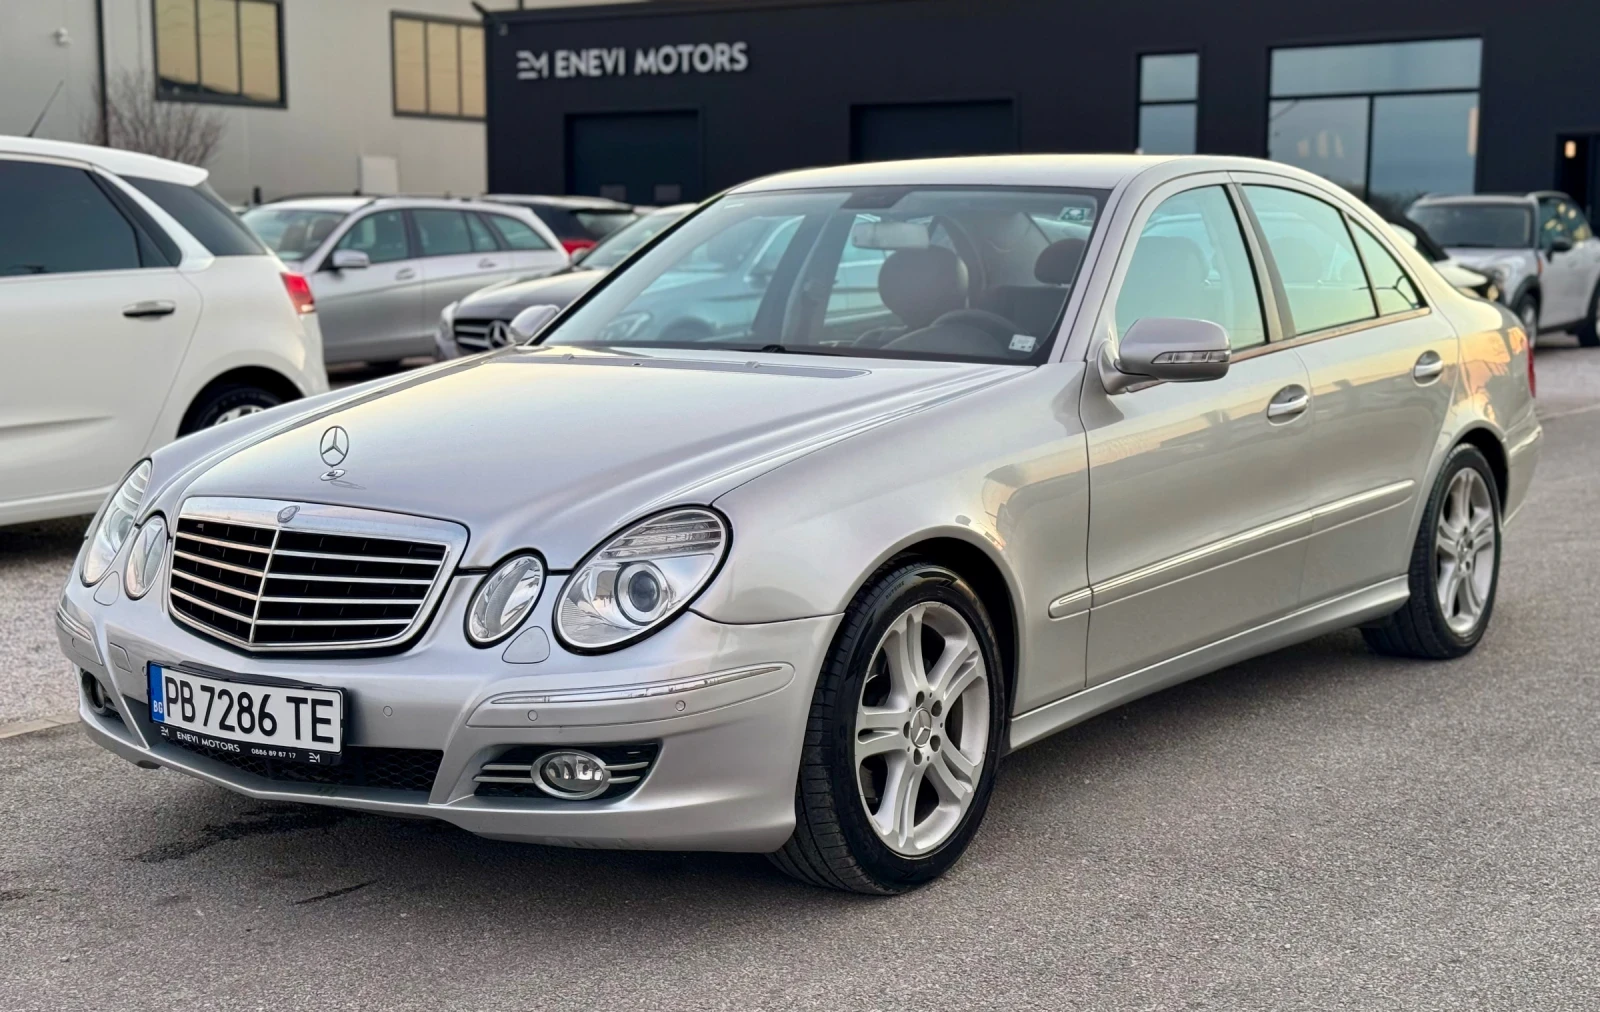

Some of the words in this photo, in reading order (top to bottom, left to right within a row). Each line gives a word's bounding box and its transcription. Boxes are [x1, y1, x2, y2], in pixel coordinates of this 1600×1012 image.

[554, 47, 626, 78] ENEVI
[633, 42, 749, 75] MOTORS
[153, 699, 163, 714] BG
[164, 675, 196, 723] PB
[200, 684, 278, 737] 7286
[286, 695, 334, 744] TE
[176, 731, 200, 745] ENEVI
[201, 737, 241, 753] MOTORS
